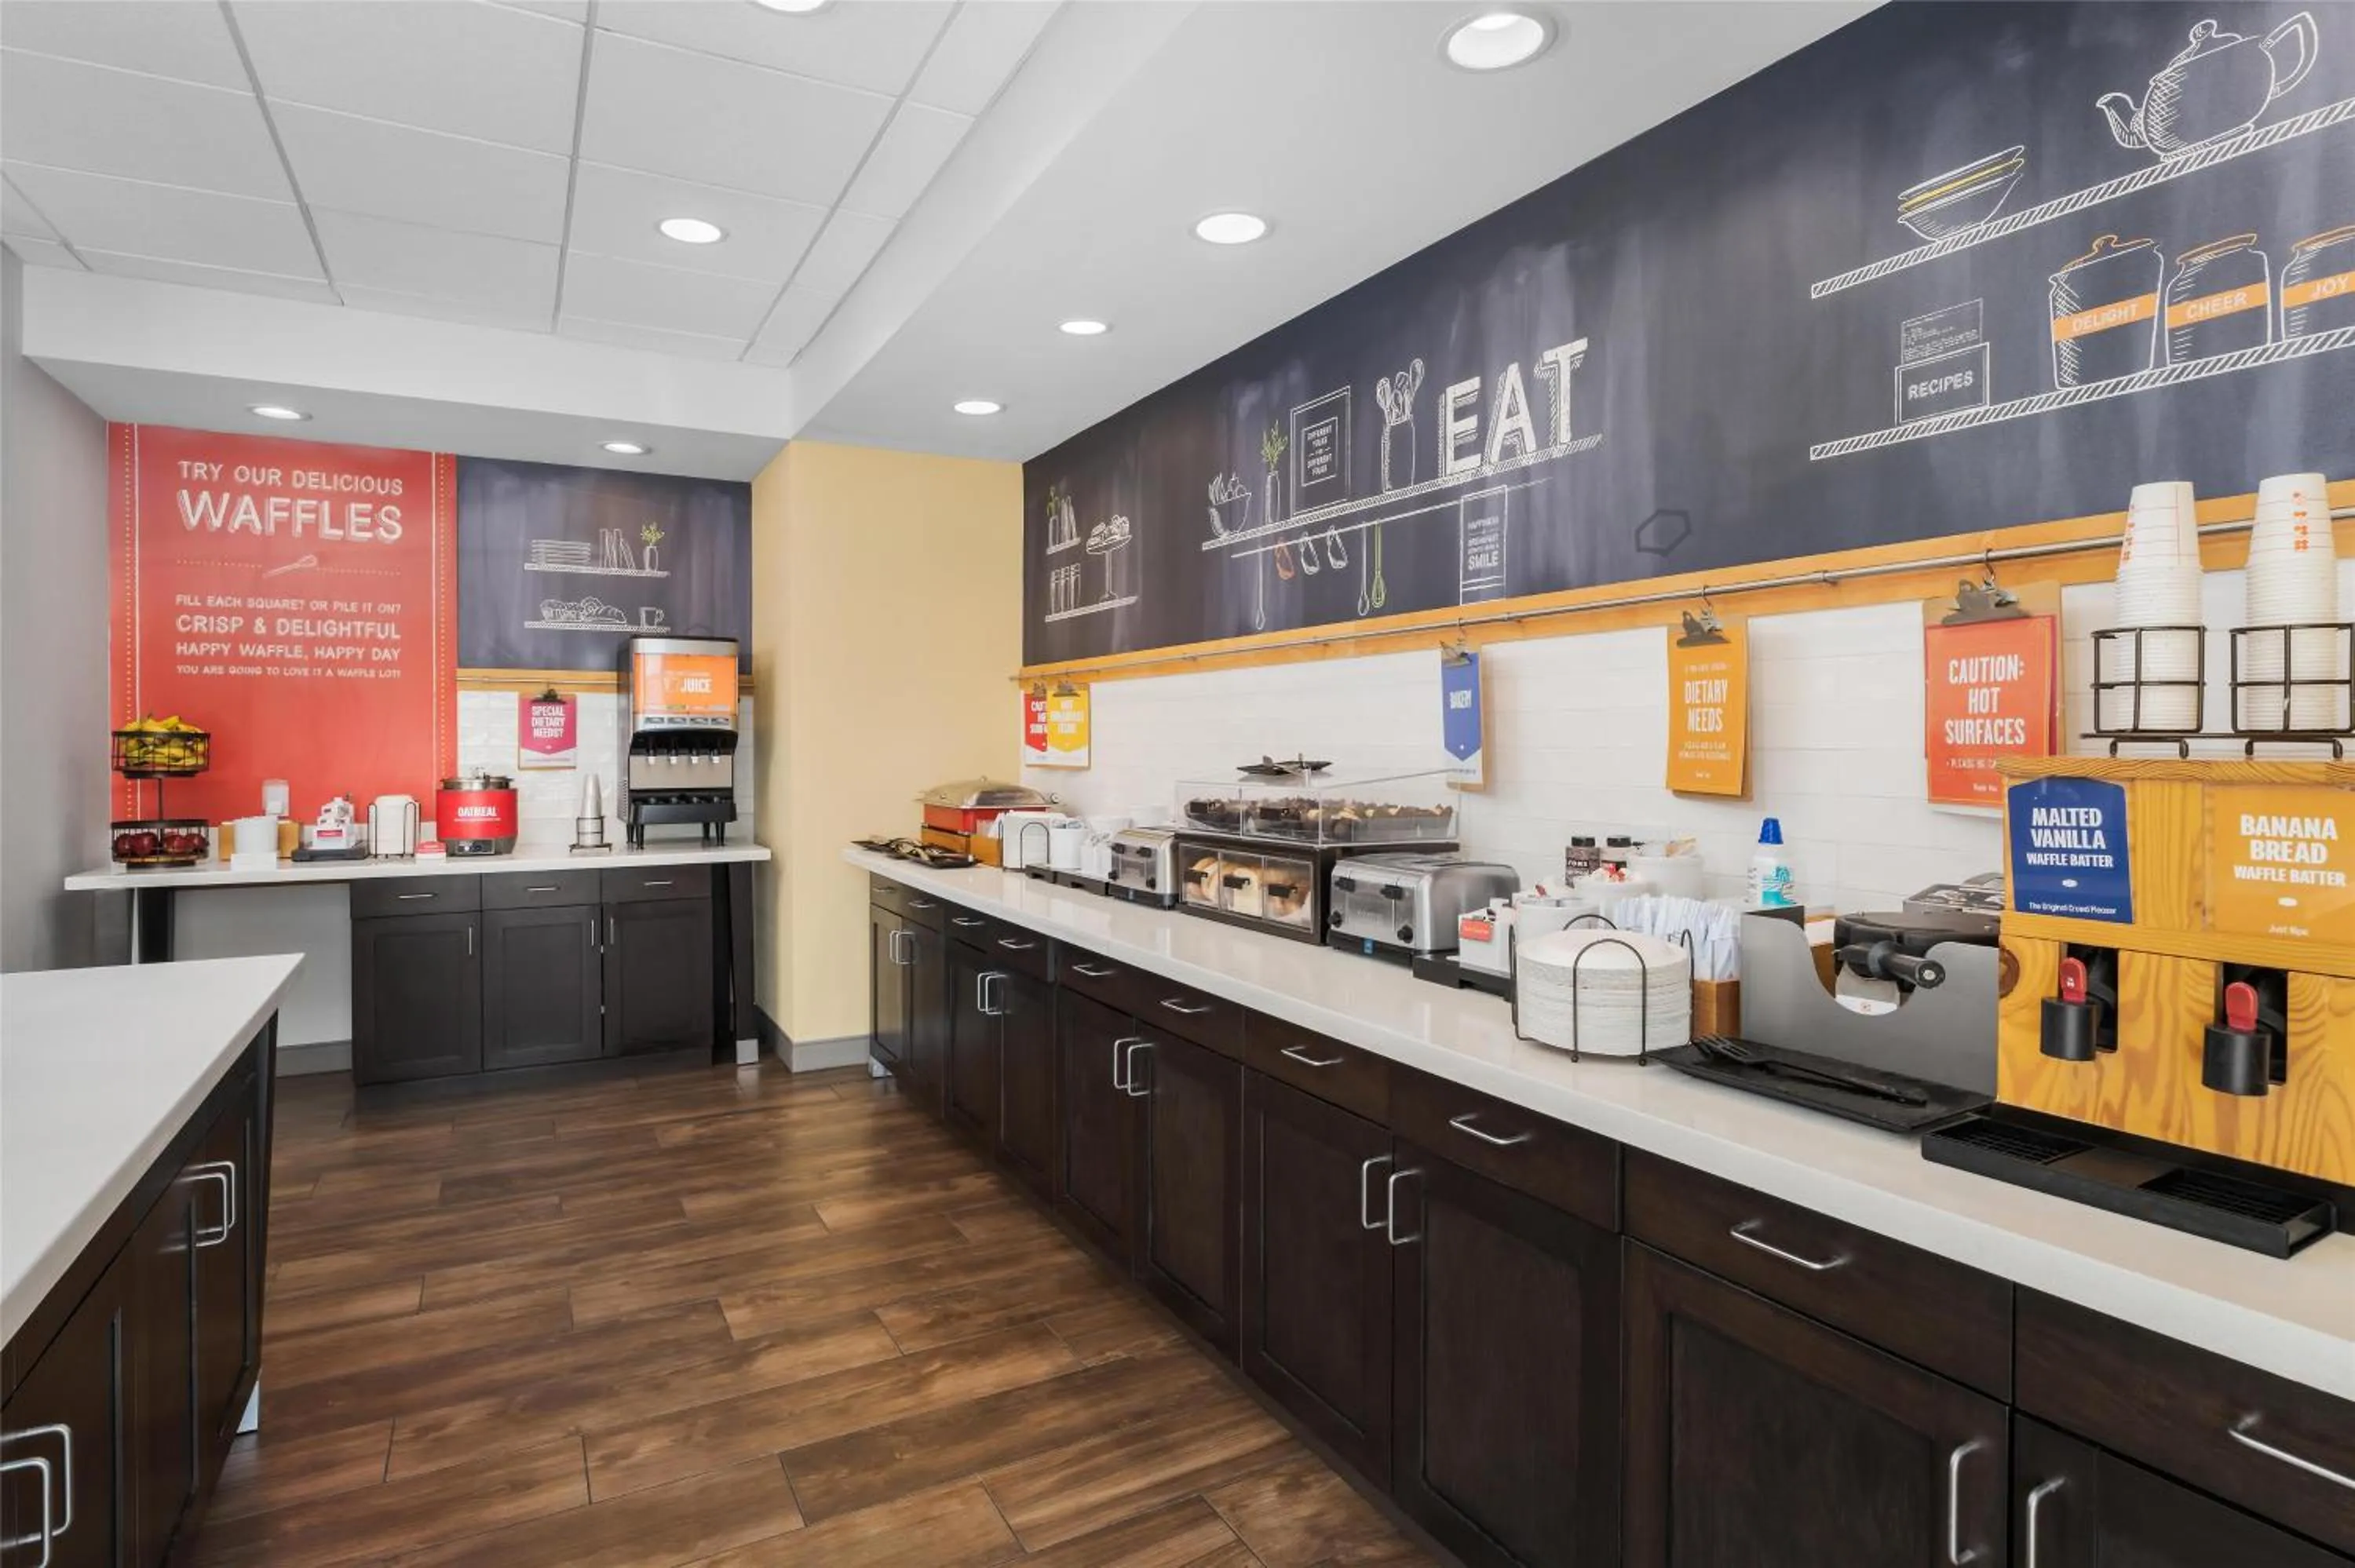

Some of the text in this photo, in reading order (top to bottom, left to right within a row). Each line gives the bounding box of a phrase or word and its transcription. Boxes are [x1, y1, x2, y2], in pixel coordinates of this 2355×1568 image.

[2310, 275, 2350, 299] JOY
[2072, 303, 2141, 333] DELIGHT
[2185, 293, 2247, 321] CHEER
[1908, 370, 1973, 401] RECIPES
[1440, 337, 1588, 477] EAT
[177, 460, 403, 495] TRY OUR DELICIOUS
[177, 489, 403, 545] WAFFLES
[1467, 550, 1499, 571] SMILE
[176, 594, 201, 607] FILL
[206, 595, 242, 608] EACH
[309, 600, 327, 611] OR
[333, 601, 358, 613] PILE
[362, 602, 372, 613] IT
[378, 603, 400, 614] ON?
[176, 614, 400, 640] CRISP & DELIGHTFUL
[176, 642, 400, 662] HAPPY WAFFLE, HAPPY DAY
[177, 665, 198, 675] YOU
[203, 665, 224, 675] ARE
[229, 665, 262, 676] GOING
[267, 666, 279, 676] TO
[283, 667, 309, 676] LOVE
[325, 668, 334, 677] A
[338, 669, 375, 678] WAFFLE
[1948, 653, 2025, 685] CAUTION:
[680, 677, 713, 693] JUICE
[1684, 680, 1728, 705] DIETARY
[531, 706, 565, 716] SPECIAL
[1968, 687, 2001, 715] HOT
[531, 717, 565, 727] DIETARY
[1688, 708, 1723, 732] NEEDS
[1944, 717, 2026, 746] SURFACES
[458, 806, 498, 817] OATMEAL
[2032, 808, 2102, 826] MALTED
[2030, 828, 2106, 849] VANILLA
[2240, 814, 2339, 841] BANANA
[2026, 852, 2114, 868] WAFFLE BATTER
[2250, 839, 2328, 865] BREAD
[2233, 865, 2346, 888] WAFFLE BATTER
[2043, 902, 2068, 912] Original
